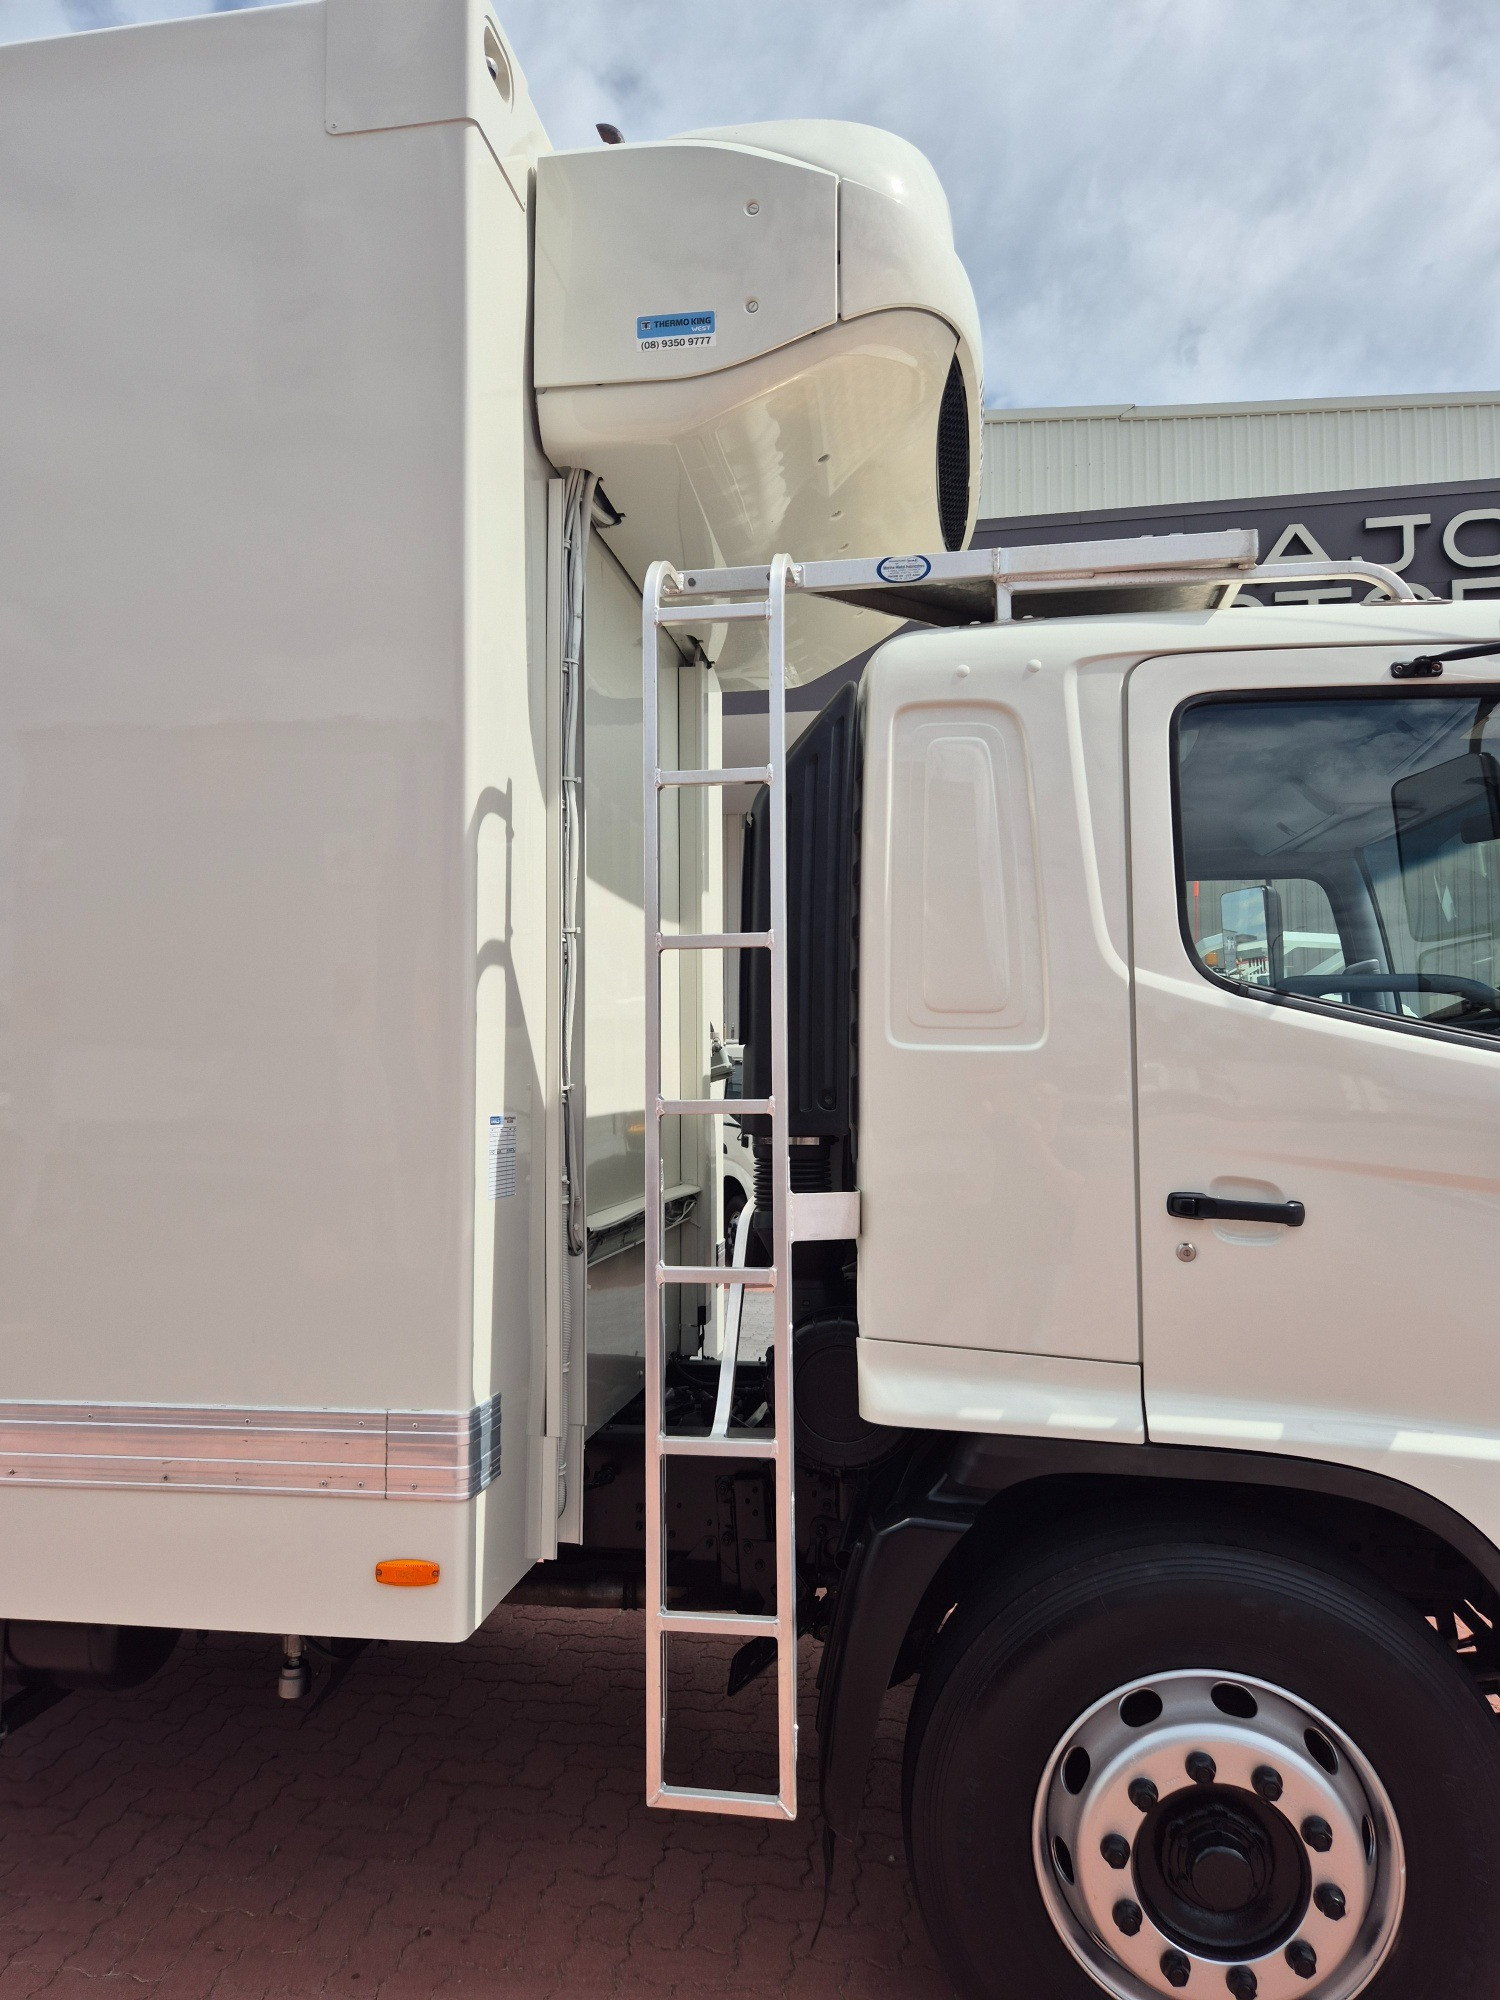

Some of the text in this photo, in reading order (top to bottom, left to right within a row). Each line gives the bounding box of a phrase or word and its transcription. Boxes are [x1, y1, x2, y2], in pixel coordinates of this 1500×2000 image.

[653, 318, 690, 329] THERMO
[690, 316, 712, 326] KING
[641, 336, 712, 352] (08) 9350 9777
[1168, 508, 1500, 575] AJO
